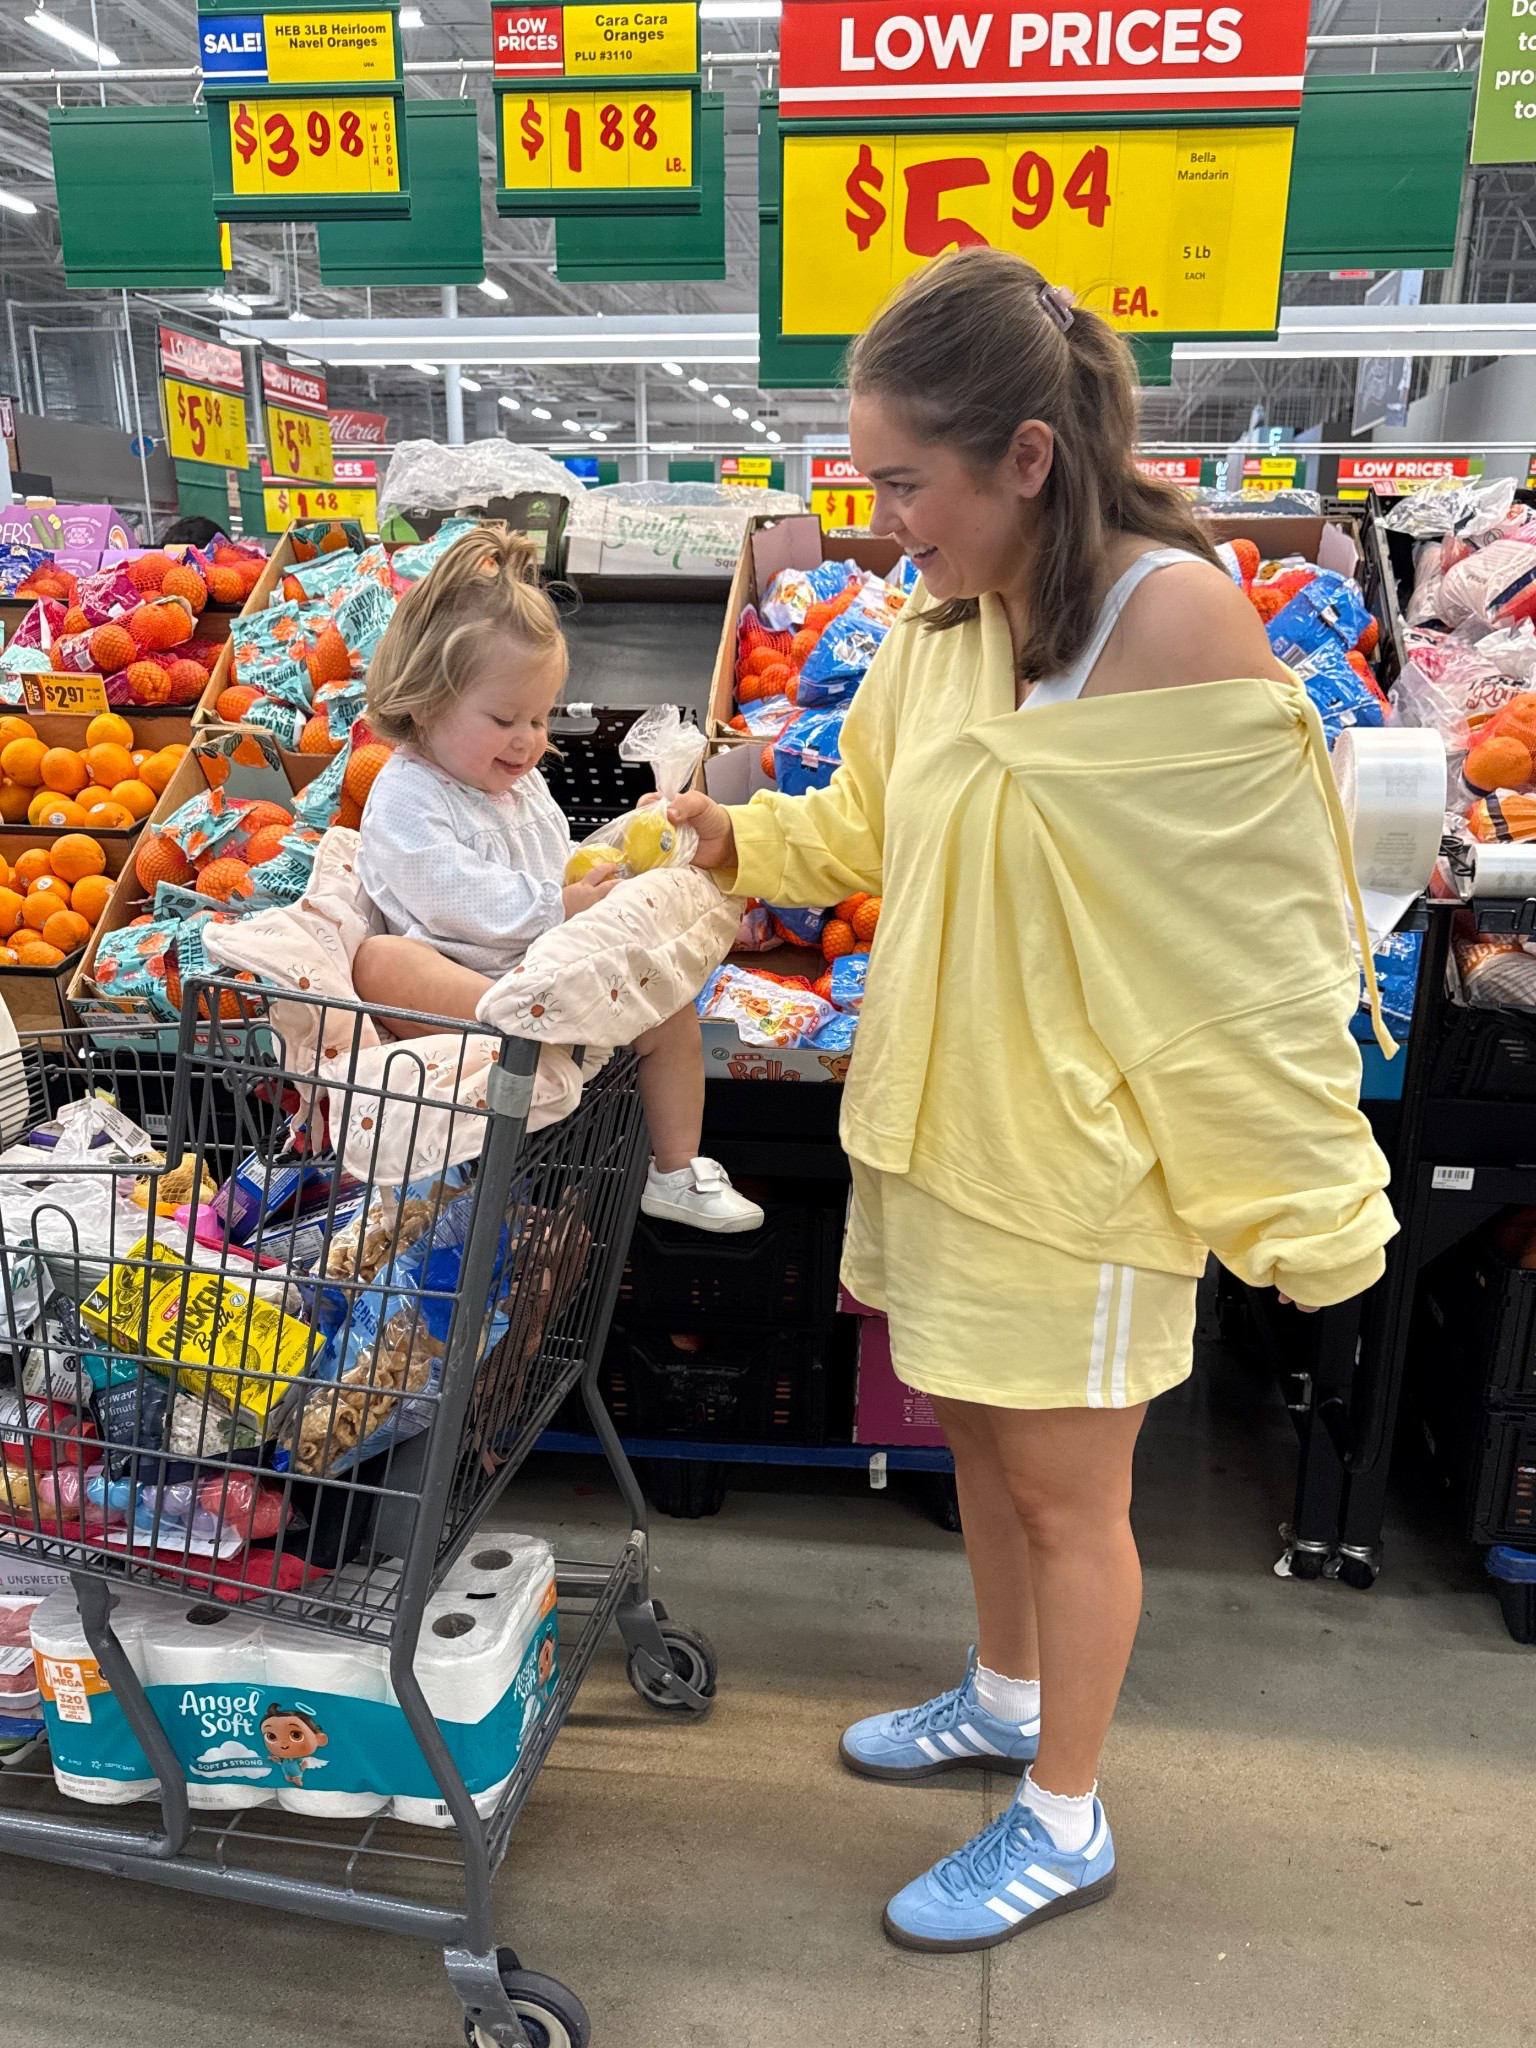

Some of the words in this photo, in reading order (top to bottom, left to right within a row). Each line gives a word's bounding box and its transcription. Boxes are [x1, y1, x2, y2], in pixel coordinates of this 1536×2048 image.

[507, 18, 547, 34] LOW
[595, 14, 629, 27] Cara
[634, 13, 668, 25] Cara
[275, 25, 300, 36] HEB
[304, 24, 328, 35] 3LB
[332, 24, 386, 35] Heirloom
[603, 28, 664, 43] Oranges
[204, 32, 262, 54] SALE!
[289, 37, 323, 49] Navel
[327, 36, 378, 49] Oranges
[498, 35, 558, 51] PRICES
[840, 14, 993, 71] LOW
[1009, 7, 1243, 68] PRICES
[574, 51, 596, 61] PLU
[600, 50, 632, 61] #3110
[666, 157, 686, 172] LB.
[1190, 152, 1216, 164] Bella
[1177, 169, 1229, 181] Mandarin
[1183, 247, 1191, 259] 5
[1196, 246, 1211, 259] Lb
[1184, 272, 1206, 281] EACH
[1113, 287, 1158, 318] EA.
[291, 378, 320, 400] PRICES
[1353, 463, 1392, 477] LOW
[1395, 462, 1454, 476] PRICES
[25, 680, 36, 705] PRICE
[31, 684, 41, 702] CUT
[727, 1060, 801, 1081] Bella
[156, 1279, 232, 1354] CHICKEN
[192, 1308, 235, 1353] Both
[55, 1666, 75, 1679] 16
[514, 1638, 539, 1701] Angel
[52, 1678, 83, 1688] MEGA
[520, 1670, 538, 1708] Soft
[59, 1694, 82, 1705] 320
[179, 1690, 260, 1717] Angel
[60, 1704, 85, 1712] SHEETS
[200, 1712, 255, 1738] Soft
[197, 1762, 220, 1771] SOFT
[229, 1759, 263, 1767] STRONG
